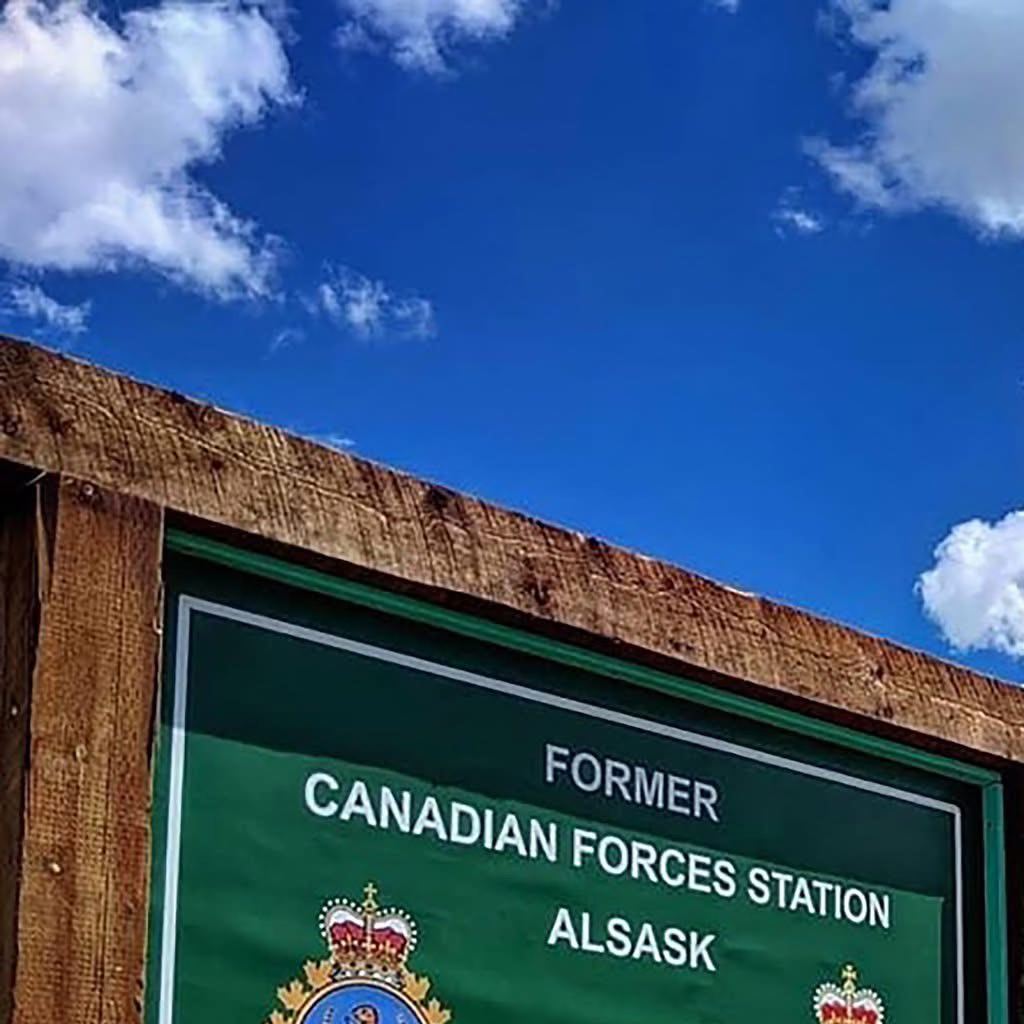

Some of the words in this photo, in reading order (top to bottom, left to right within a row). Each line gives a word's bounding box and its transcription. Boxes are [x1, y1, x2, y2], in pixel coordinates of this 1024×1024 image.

[545, 743, 720, 823] FORMER
[304, 772, 558, 863] CANADIAN
[572, 828, 736, 898] FORCES
[747, 867, 890, 928] STATION
[547, 907, 717, 971] ALSASK
